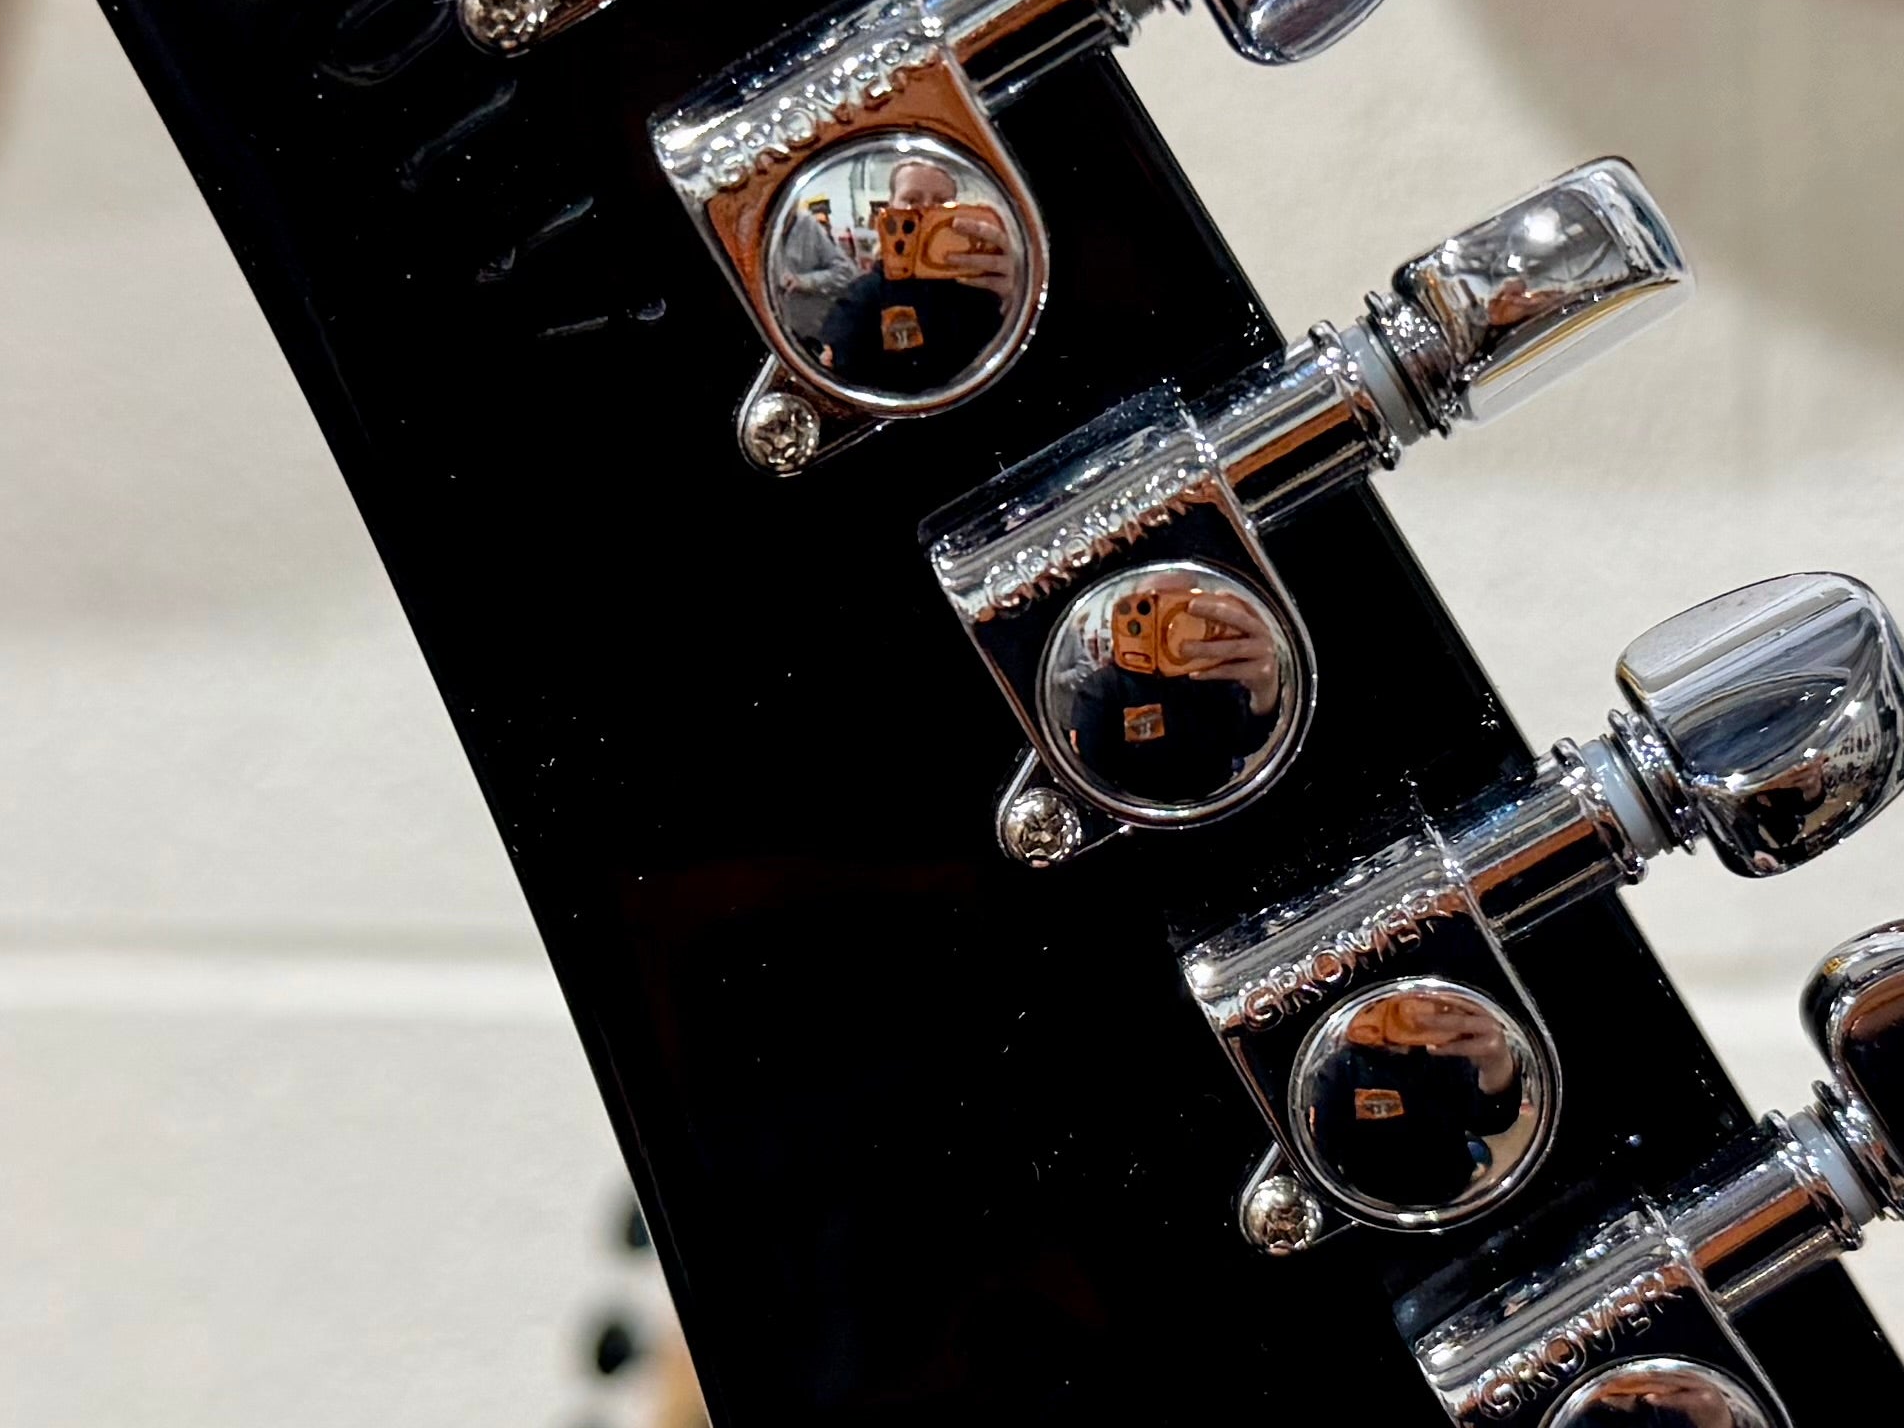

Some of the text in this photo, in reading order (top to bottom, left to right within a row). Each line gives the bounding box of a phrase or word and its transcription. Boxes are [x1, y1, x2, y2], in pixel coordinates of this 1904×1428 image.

[691, 21, 944, 203] GROVER
[976, 456, 1210, 623] GROVER
[1228, 881, 1455, 1040] GROVER
[1463, 1266, 1690, 1427] GROVER
